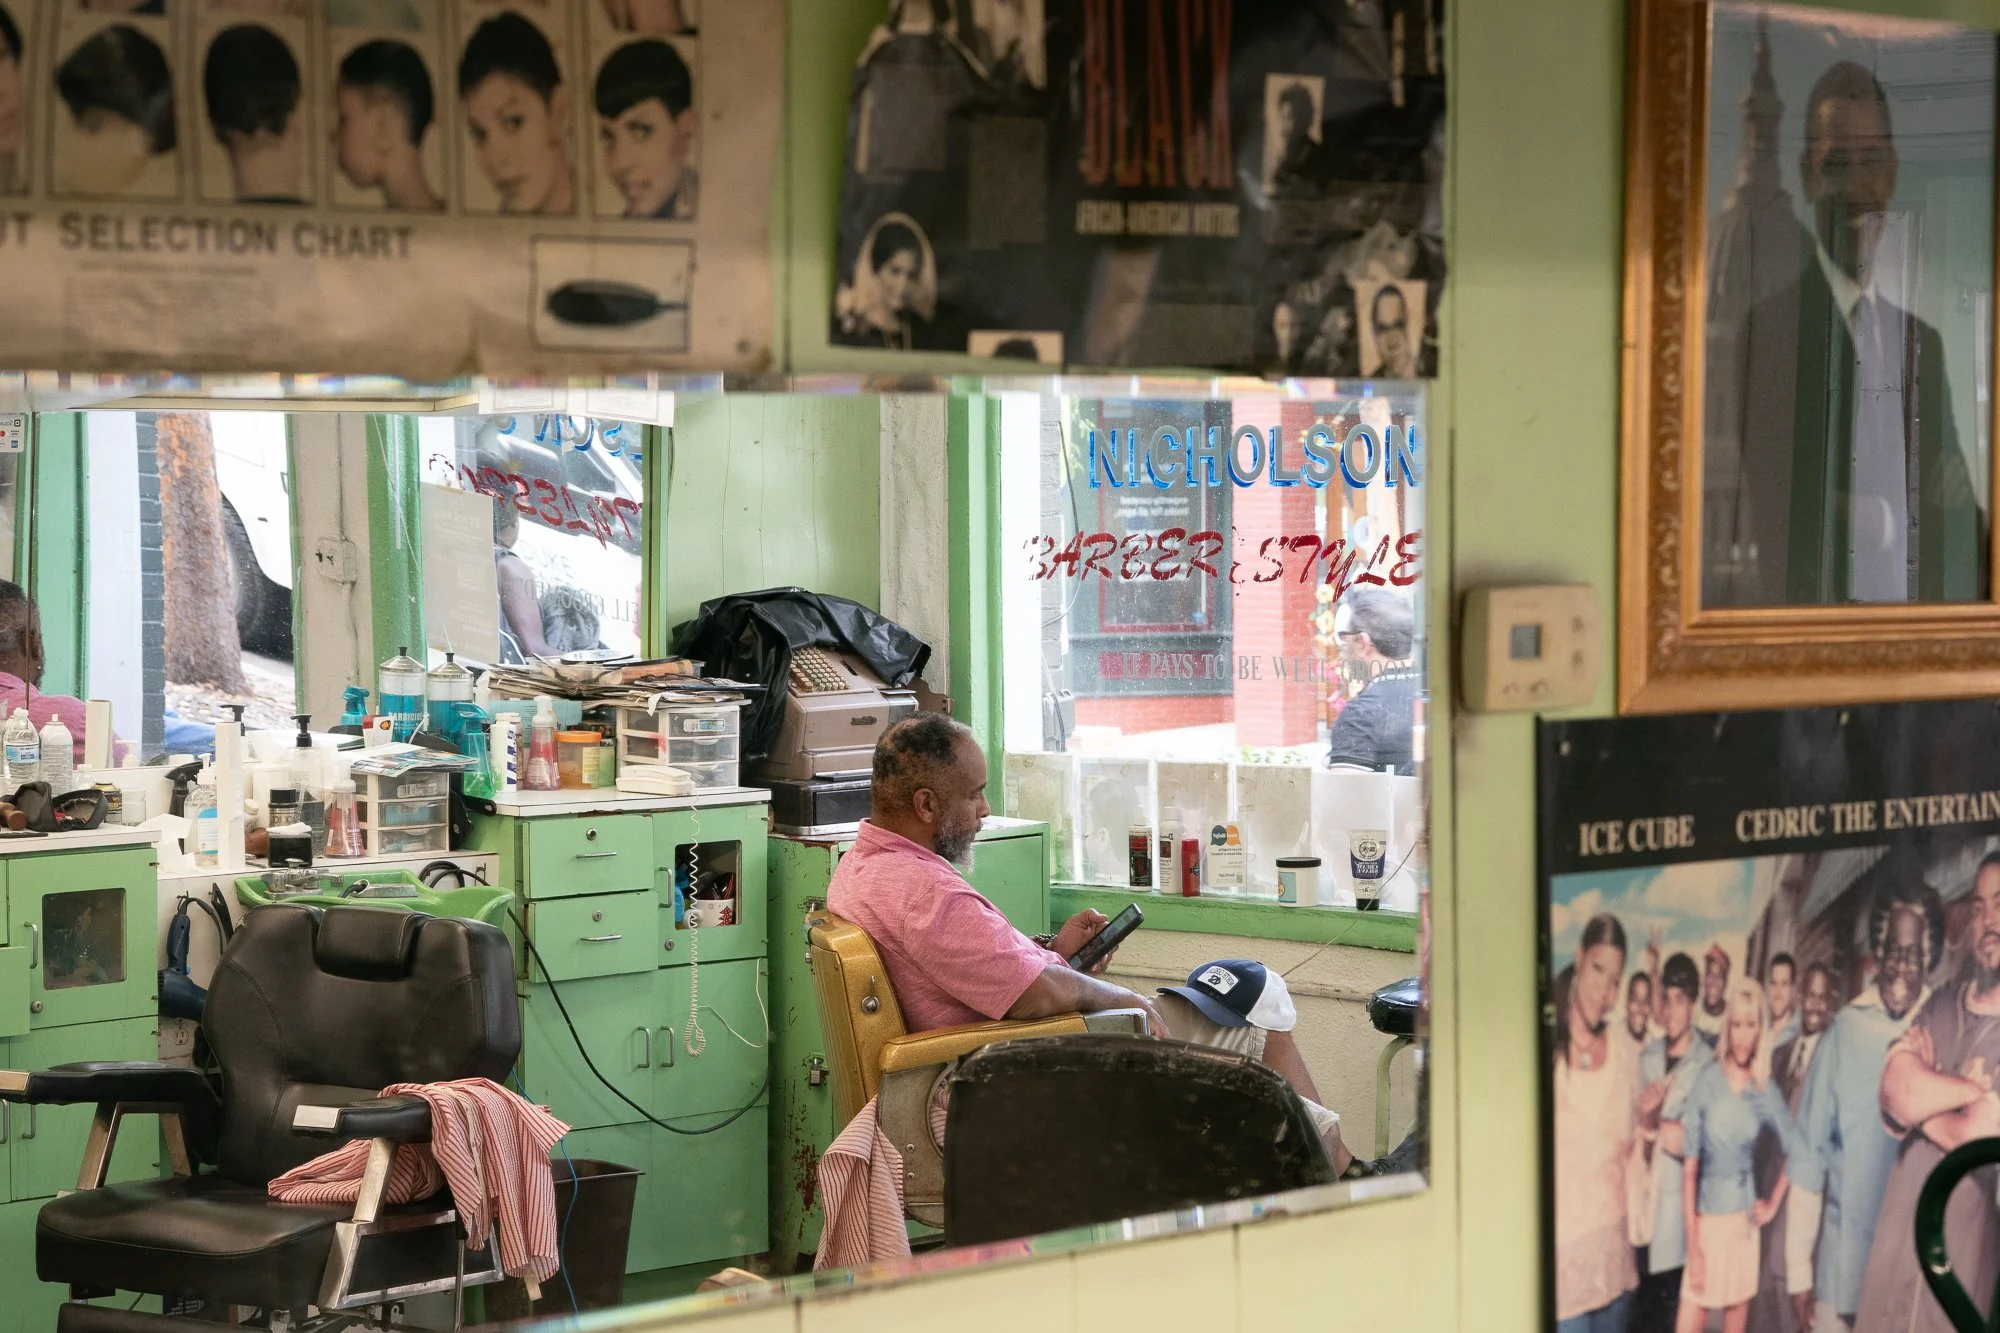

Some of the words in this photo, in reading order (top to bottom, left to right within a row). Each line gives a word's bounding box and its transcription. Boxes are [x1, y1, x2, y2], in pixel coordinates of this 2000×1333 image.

[59, 212, 277, 256] SELECTION
[291, 220, 411, 261] CHART
[1088, 423, 1422, 488] NICHOLSON
[1122, 652, 1140, 678] IT
[1148, 652, 1194, 680] PAYS
[1201, 653, 1226, 681] TO
[1238, 655, 1263, 681] BE
[1272, 656, 1329, 684] WELL
[1579, 821, 1625, 857] ICE
[1628, 815, 1696, 849] CUBE
[1736, 807, 1825, 843] CEDRIC
[1832, 800, 1877, 835] THE
